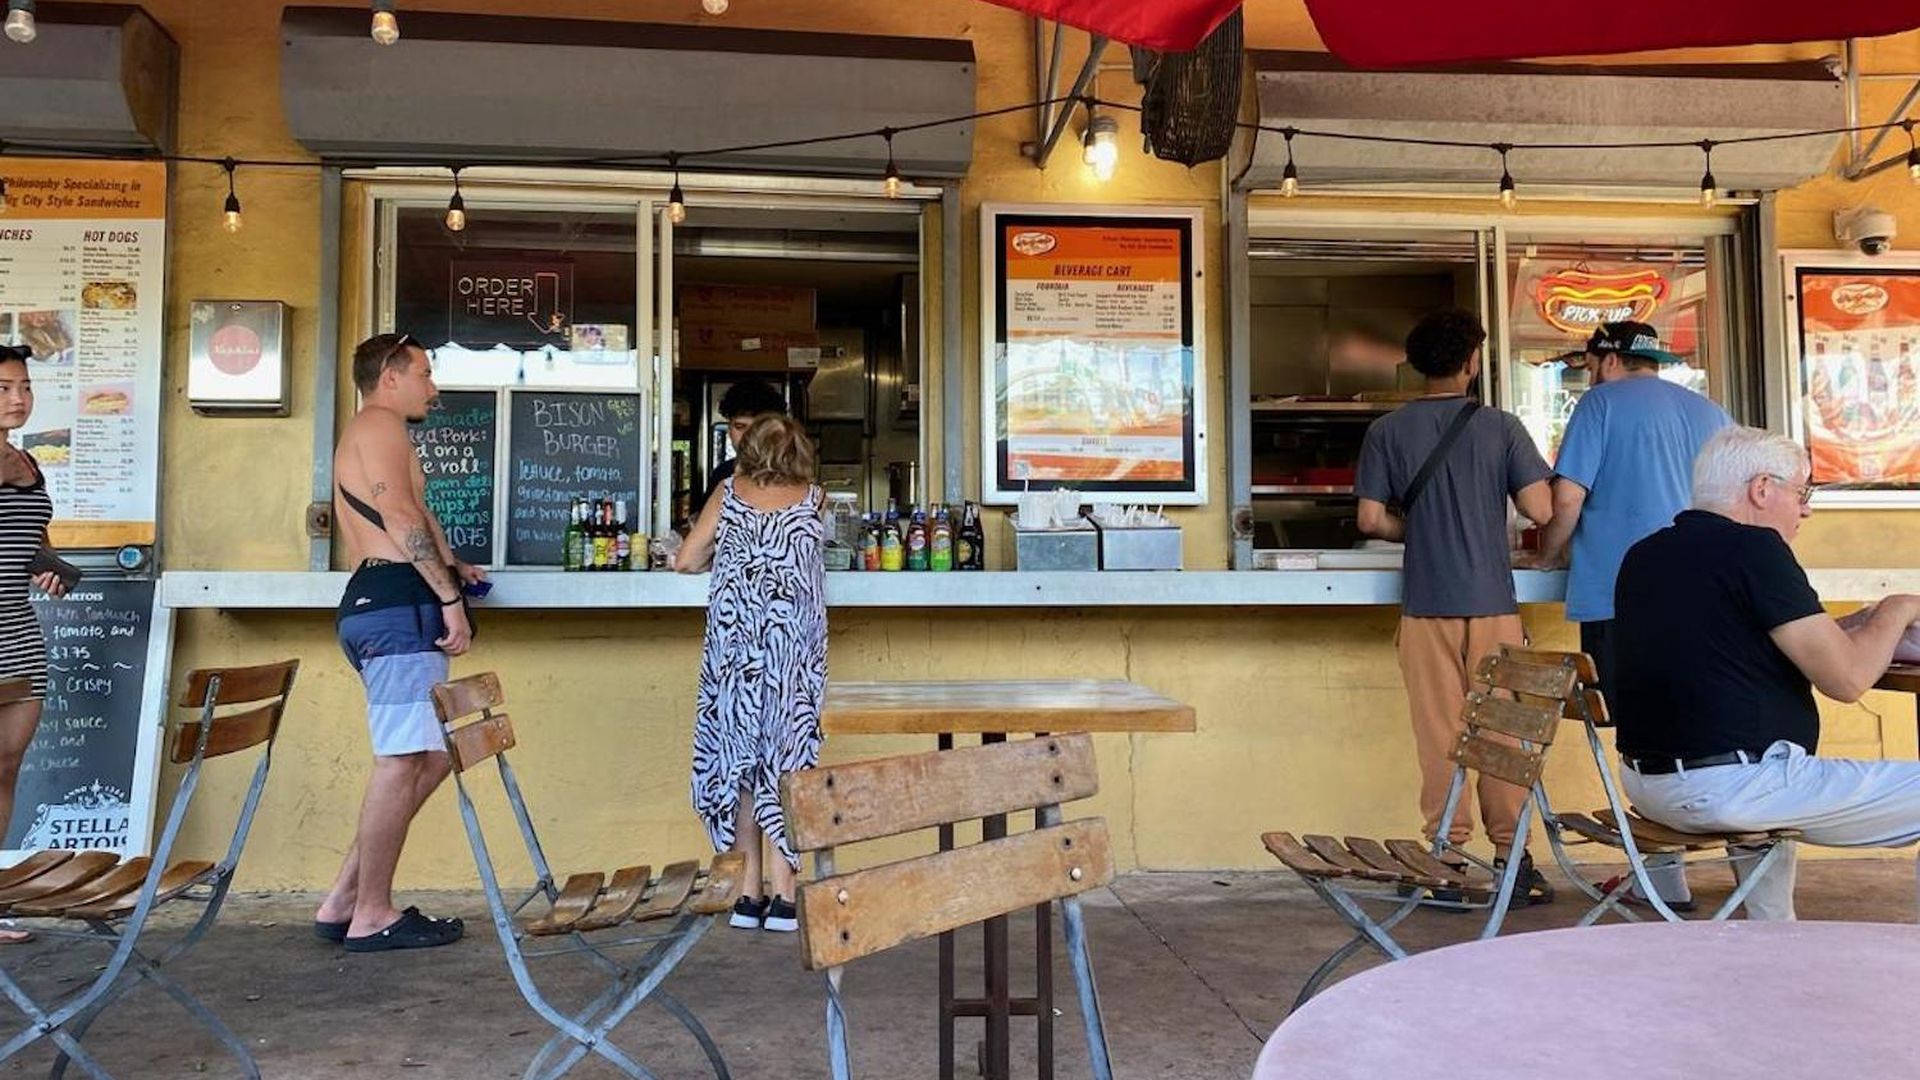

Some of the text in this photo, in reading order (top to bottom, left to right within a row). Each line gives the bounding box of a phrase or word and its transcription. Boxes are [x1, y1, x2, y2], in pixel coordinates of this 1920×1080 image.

[3, 177, 141, 192] Philosophy Specializing in
[23, 194, 42, 208] City
[47, 194, 74, 208] Style
[77, 196, 140, 209] Sandwiches
[83, 231, 140, 243] HOT DOGS
[1054, 264, 1132, 277] BEVERAGE CART
[458, 276, 534, 295] ORDER
[466, 298, 524, 315] HERE
[1562, 305, 1633, 322] PICK UP
[533, 399, 605, 428] BISON
[543, 429, 621, 459] BURGER
[434, 446, 459, 458] on
[463, 446, 475, 459] a
[440, 458, 481, 474] roll
[62, 592, 104, 602] ARTOIS
[110, 625, 135, 637] and
[60, 734, 85, 747] and
[50, 817, 129, 835] STELLA
